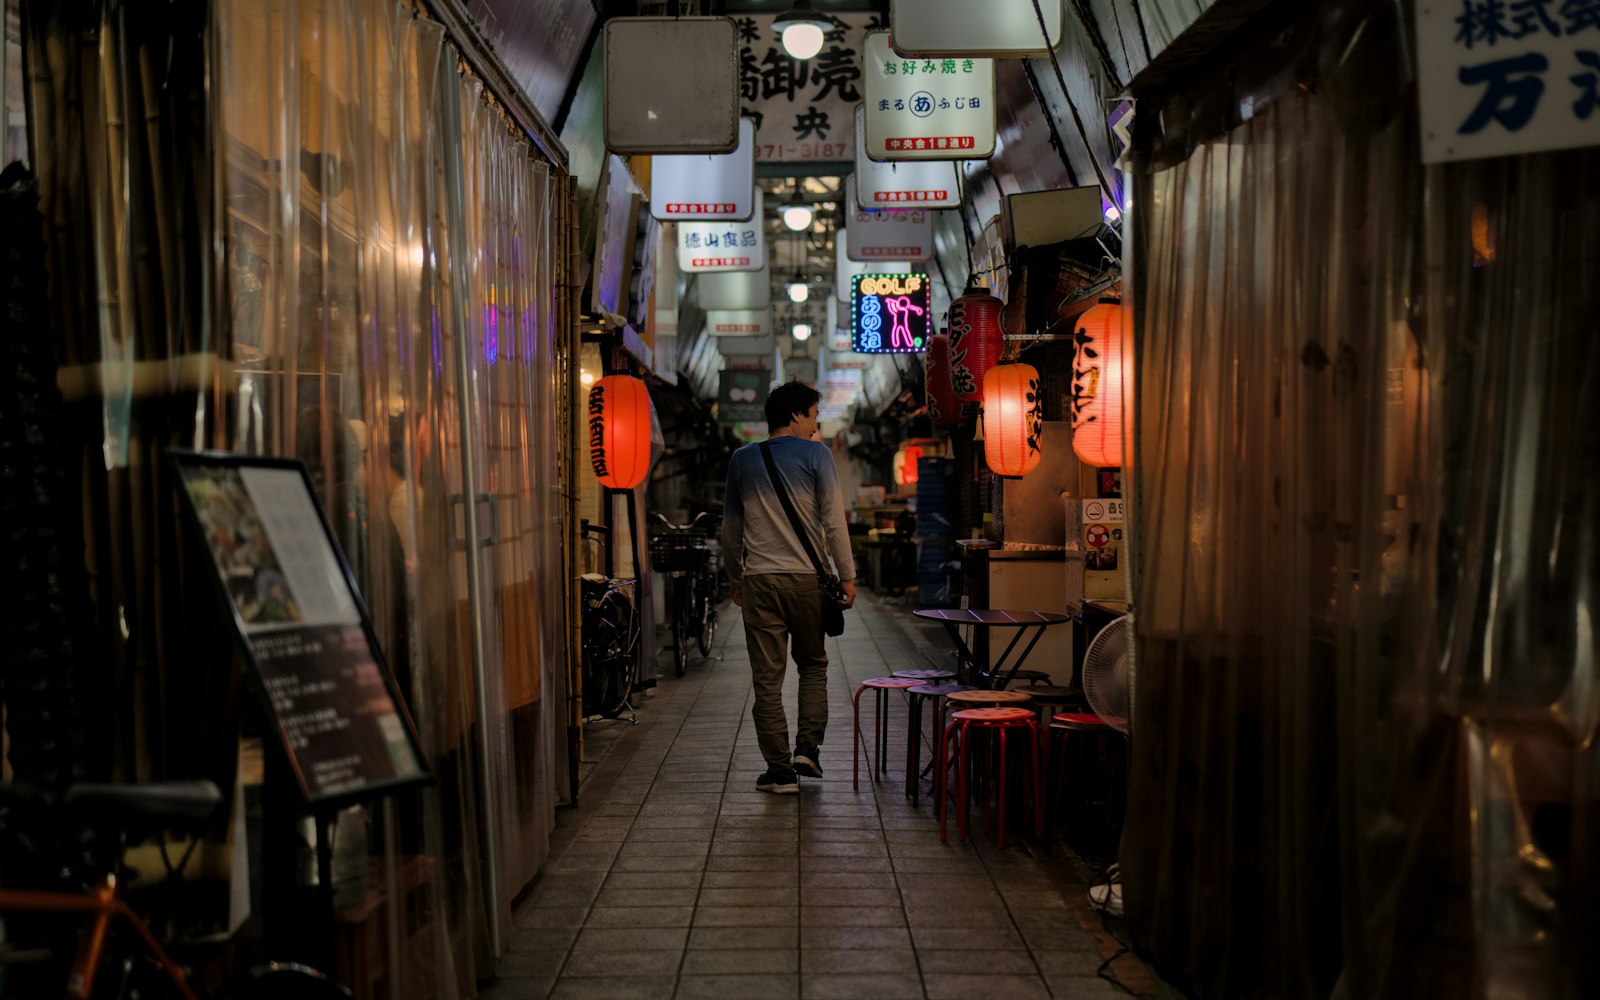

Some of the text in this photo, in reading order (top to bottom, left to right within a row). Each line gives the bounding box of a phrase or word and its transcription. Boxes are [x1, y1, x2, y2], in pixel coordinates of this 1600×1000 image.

[883, 58, 974, 75] お好み焼き
[861, 277, 922, 295] GOLF
[860, 294, 882, 349] あのね
